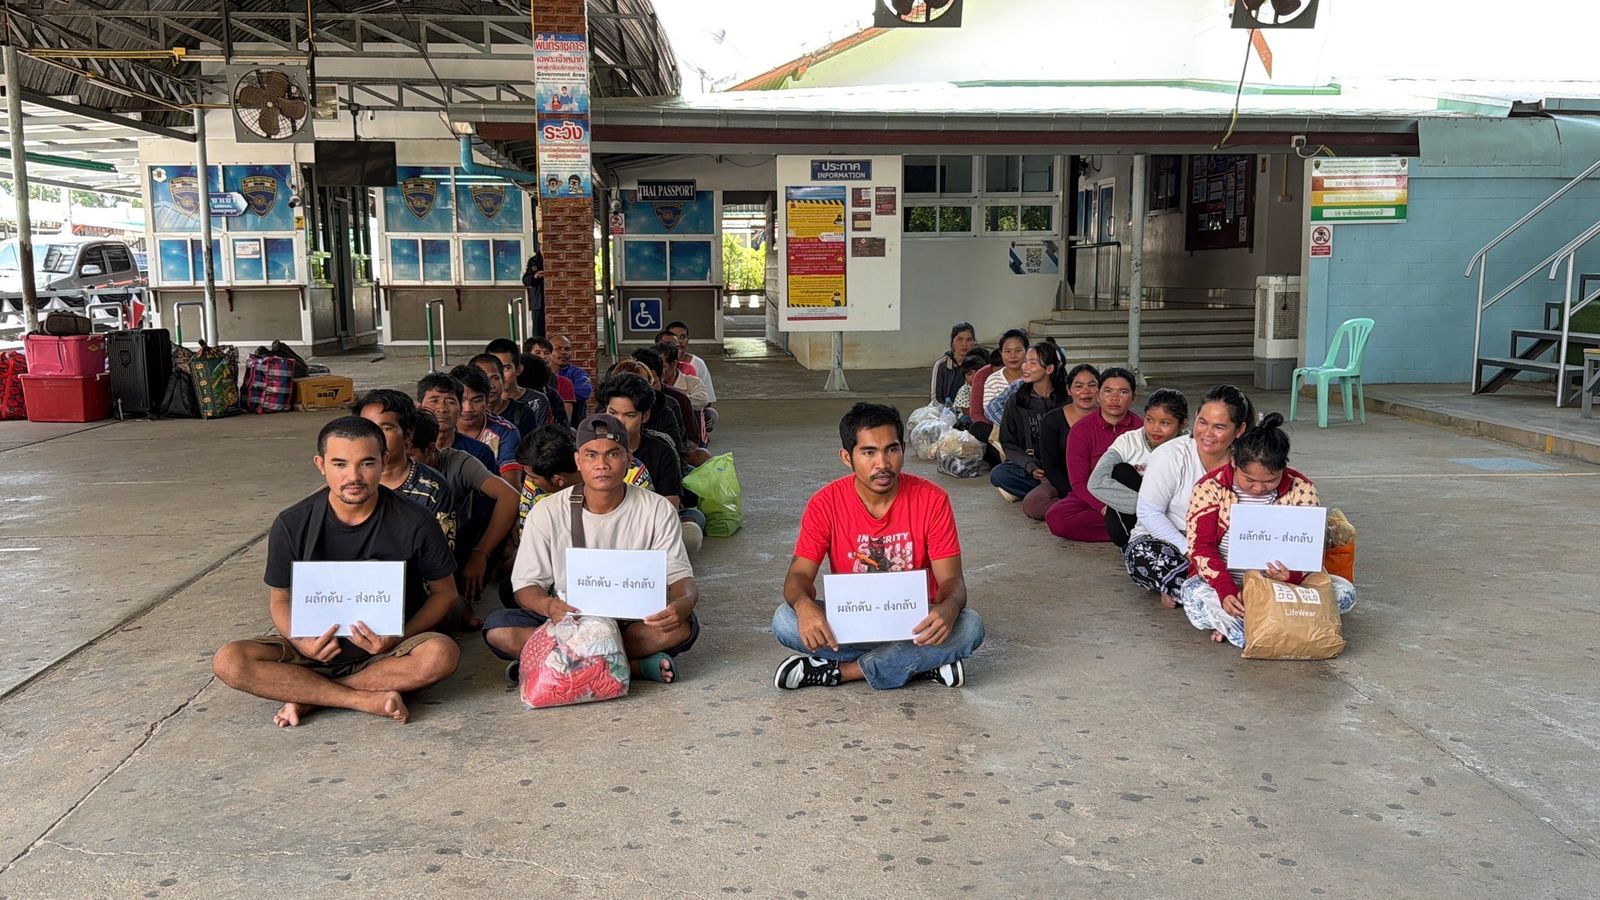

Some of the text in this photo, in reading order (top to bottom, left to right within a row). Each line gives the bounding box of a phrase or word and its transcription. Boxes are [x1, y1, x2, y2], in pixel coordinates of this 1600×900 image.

[535, 34, 585, 51] พื้นที่ราชการ
[544, 122, 583, 140] ระวัง
[822, 161, 861, 171] ประกาศ
[638, 184, 694, 197] THAI PASSPORT
[1239, 530, 1271, 542] ผลักดัน
[1282, 532, 1314, 544] ส่งกลับ
[577, 575, 611, 588] ผลักดัน
[622, 577, 655, 590] ส่งกลับ
[305, 591, 343, 604] ผลักดัน
[355, 590, 391, 603] ส่งกลับ
[837, 601, 873, 613] ผลักดัน
[883, 598, 917, 612] ส่งกลับ
[1284, 608, 1317, 617] LifeWear
